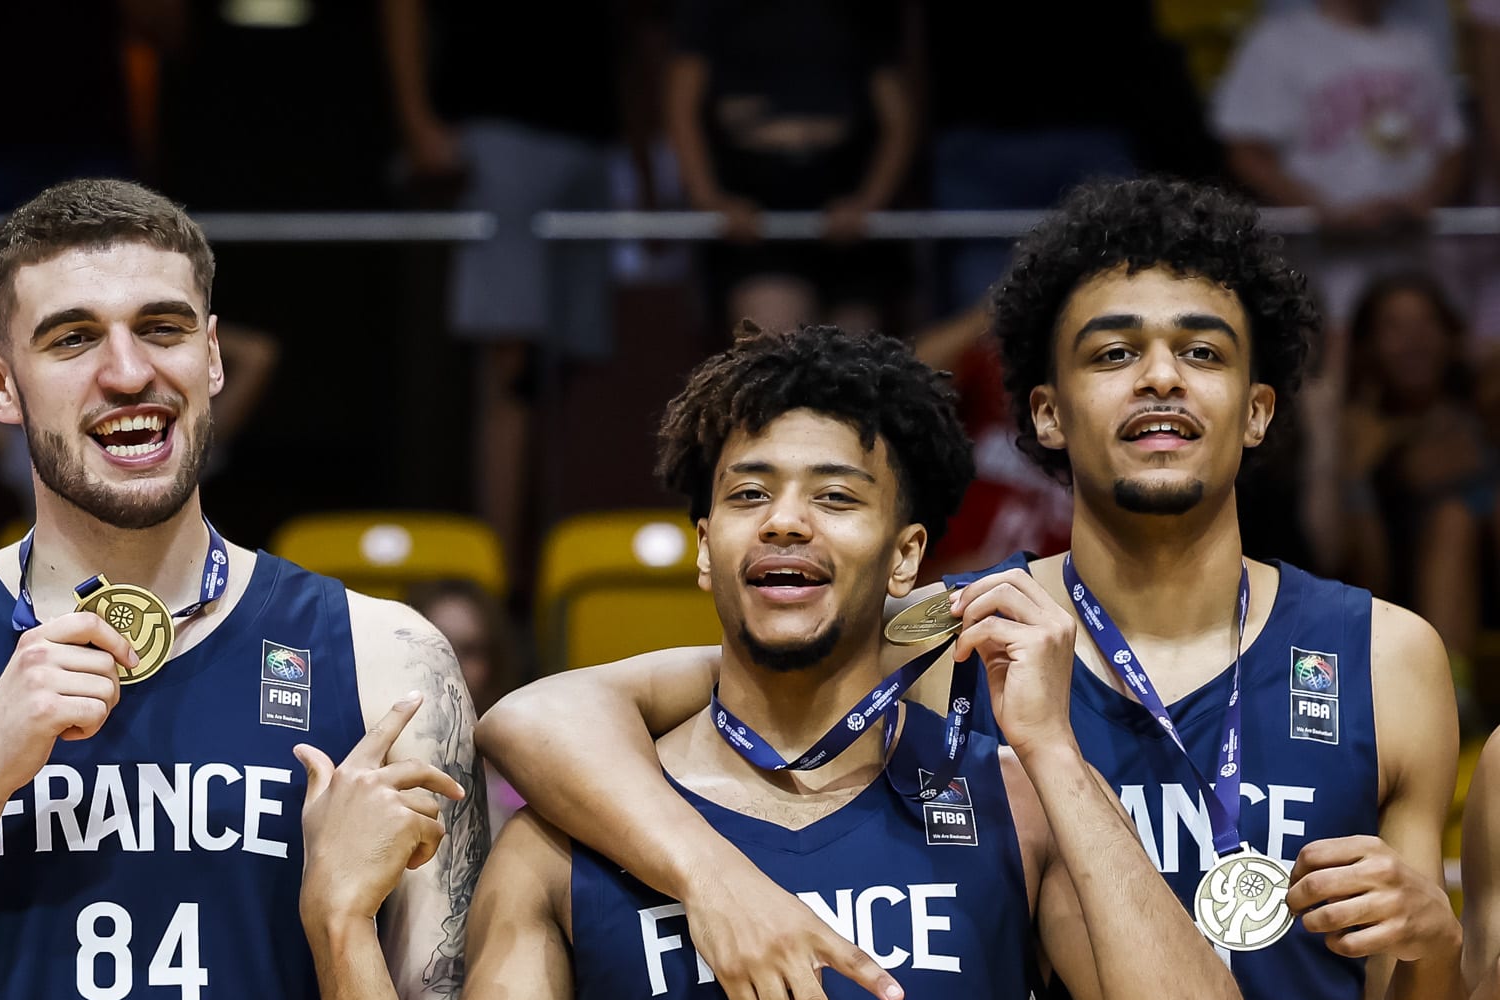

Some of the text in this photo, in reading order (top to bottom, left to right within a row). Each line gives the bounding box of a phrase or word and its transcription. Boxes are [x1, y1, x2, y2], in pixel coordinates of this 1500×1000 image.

[269, 688, 301, 707] FIBA
[1298, 700, 1330, 719] FIBA
[932, 811, 966, 825] FIBA
